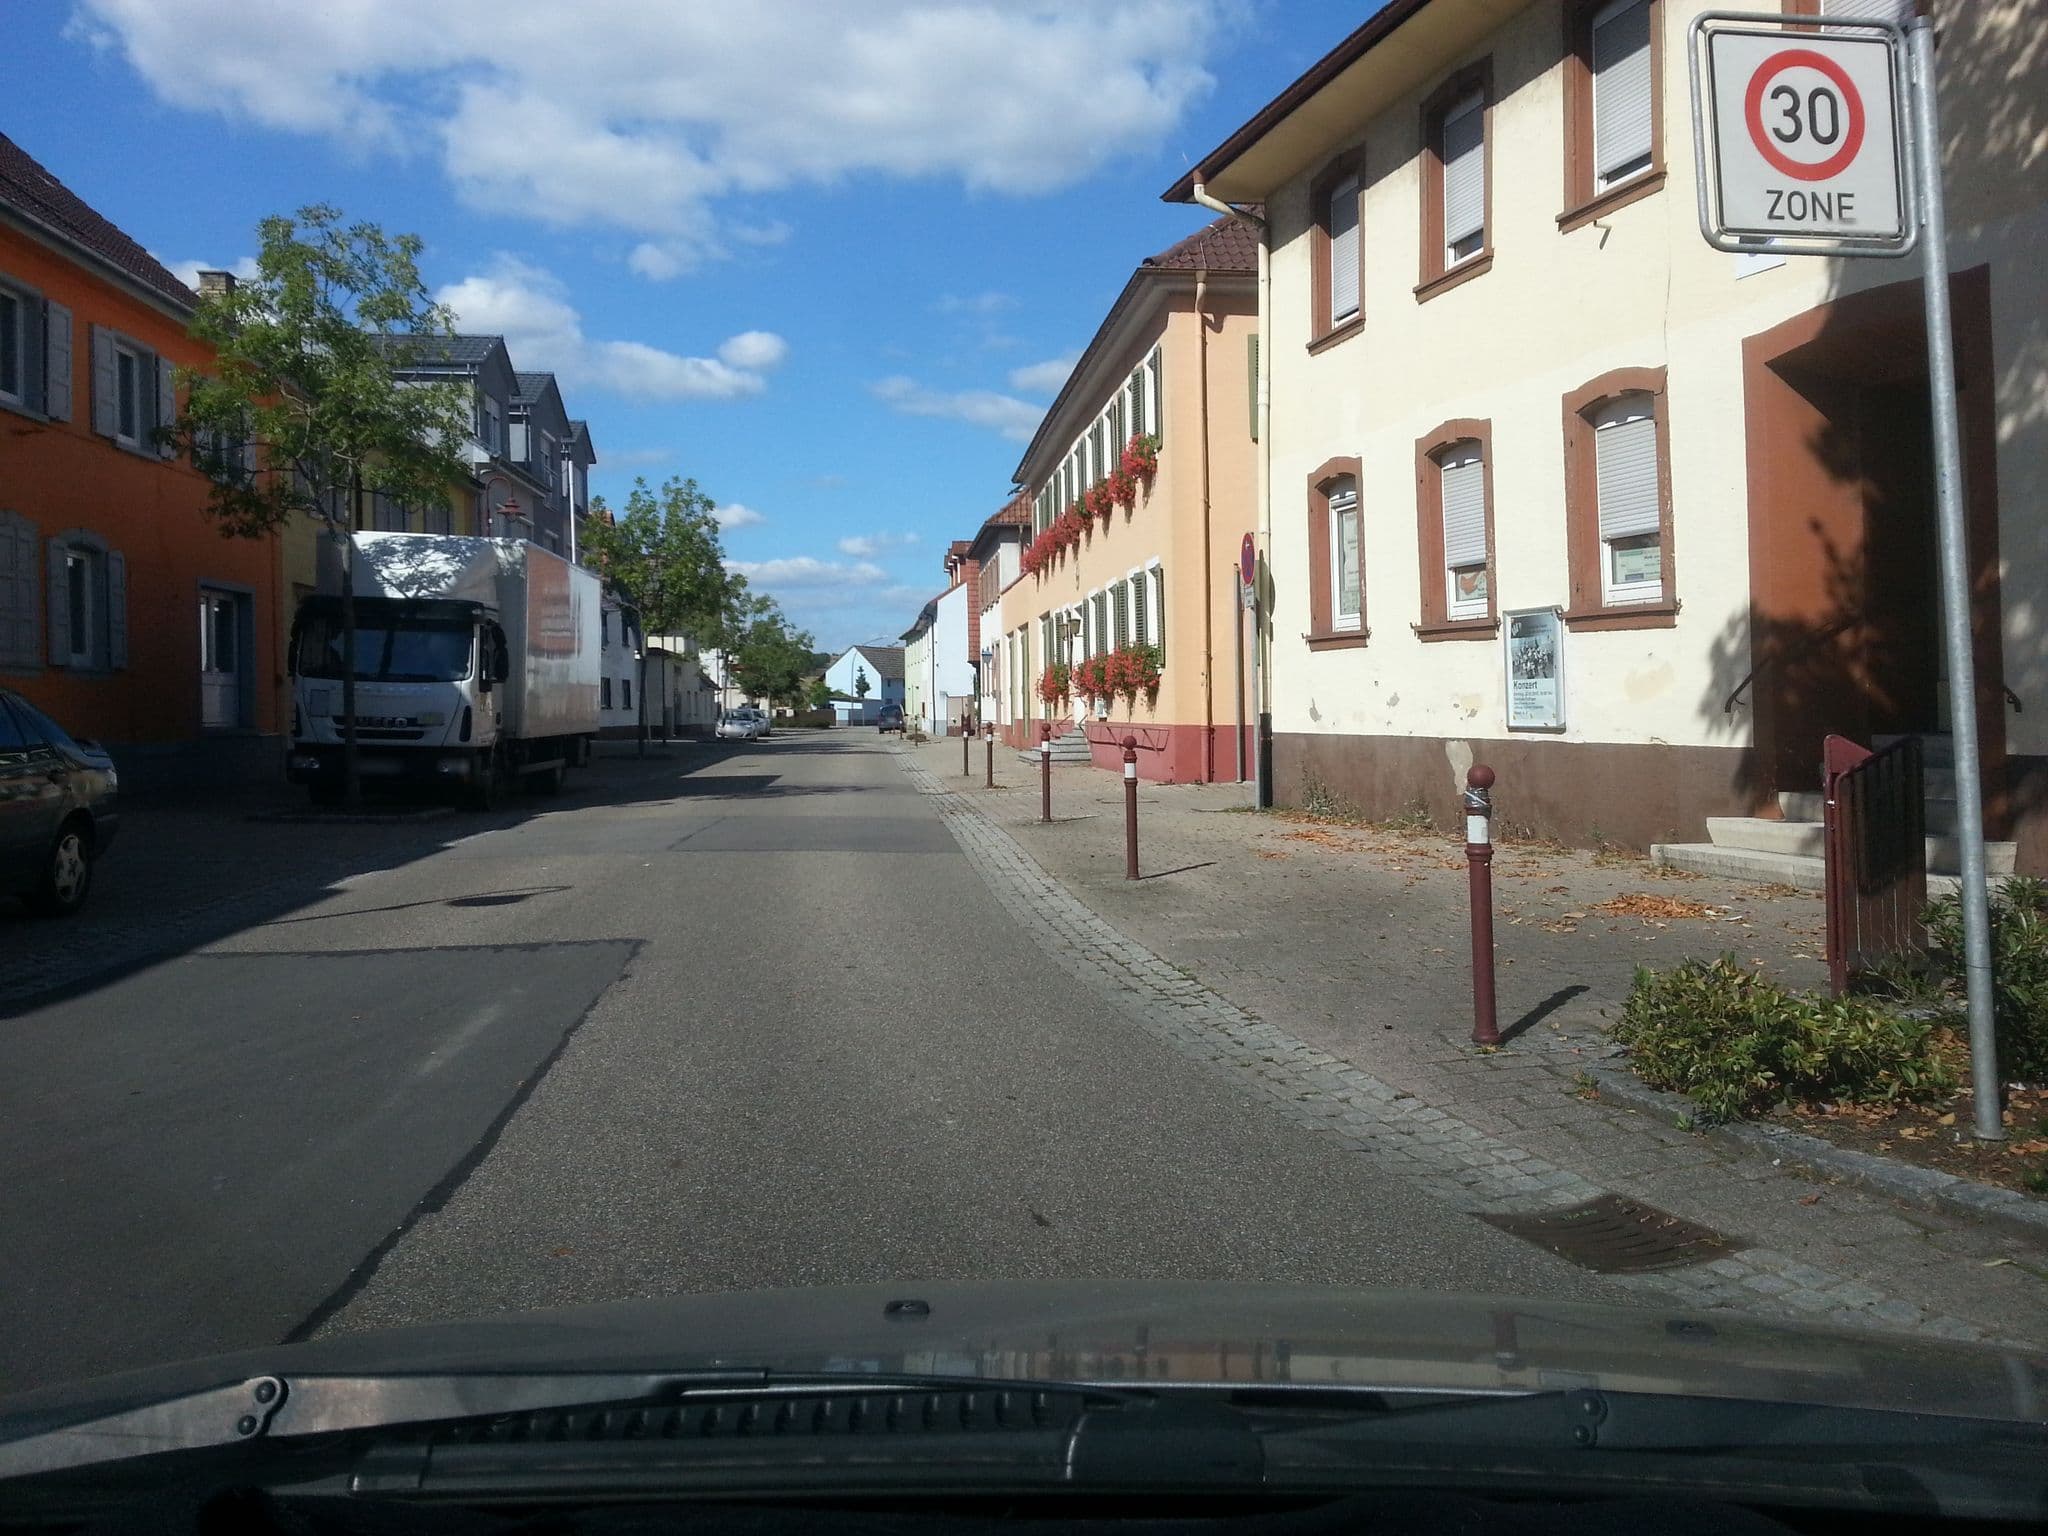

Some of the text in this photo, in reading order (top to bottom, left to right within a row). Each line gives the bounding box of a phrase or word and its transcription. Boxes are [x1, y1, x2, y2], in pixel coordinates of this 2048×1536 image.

[1770, 85, 1840, 145] 30
[1766, 189, 1855, 222] ZONE
[1513, 681, 1538, 690] Konzert
